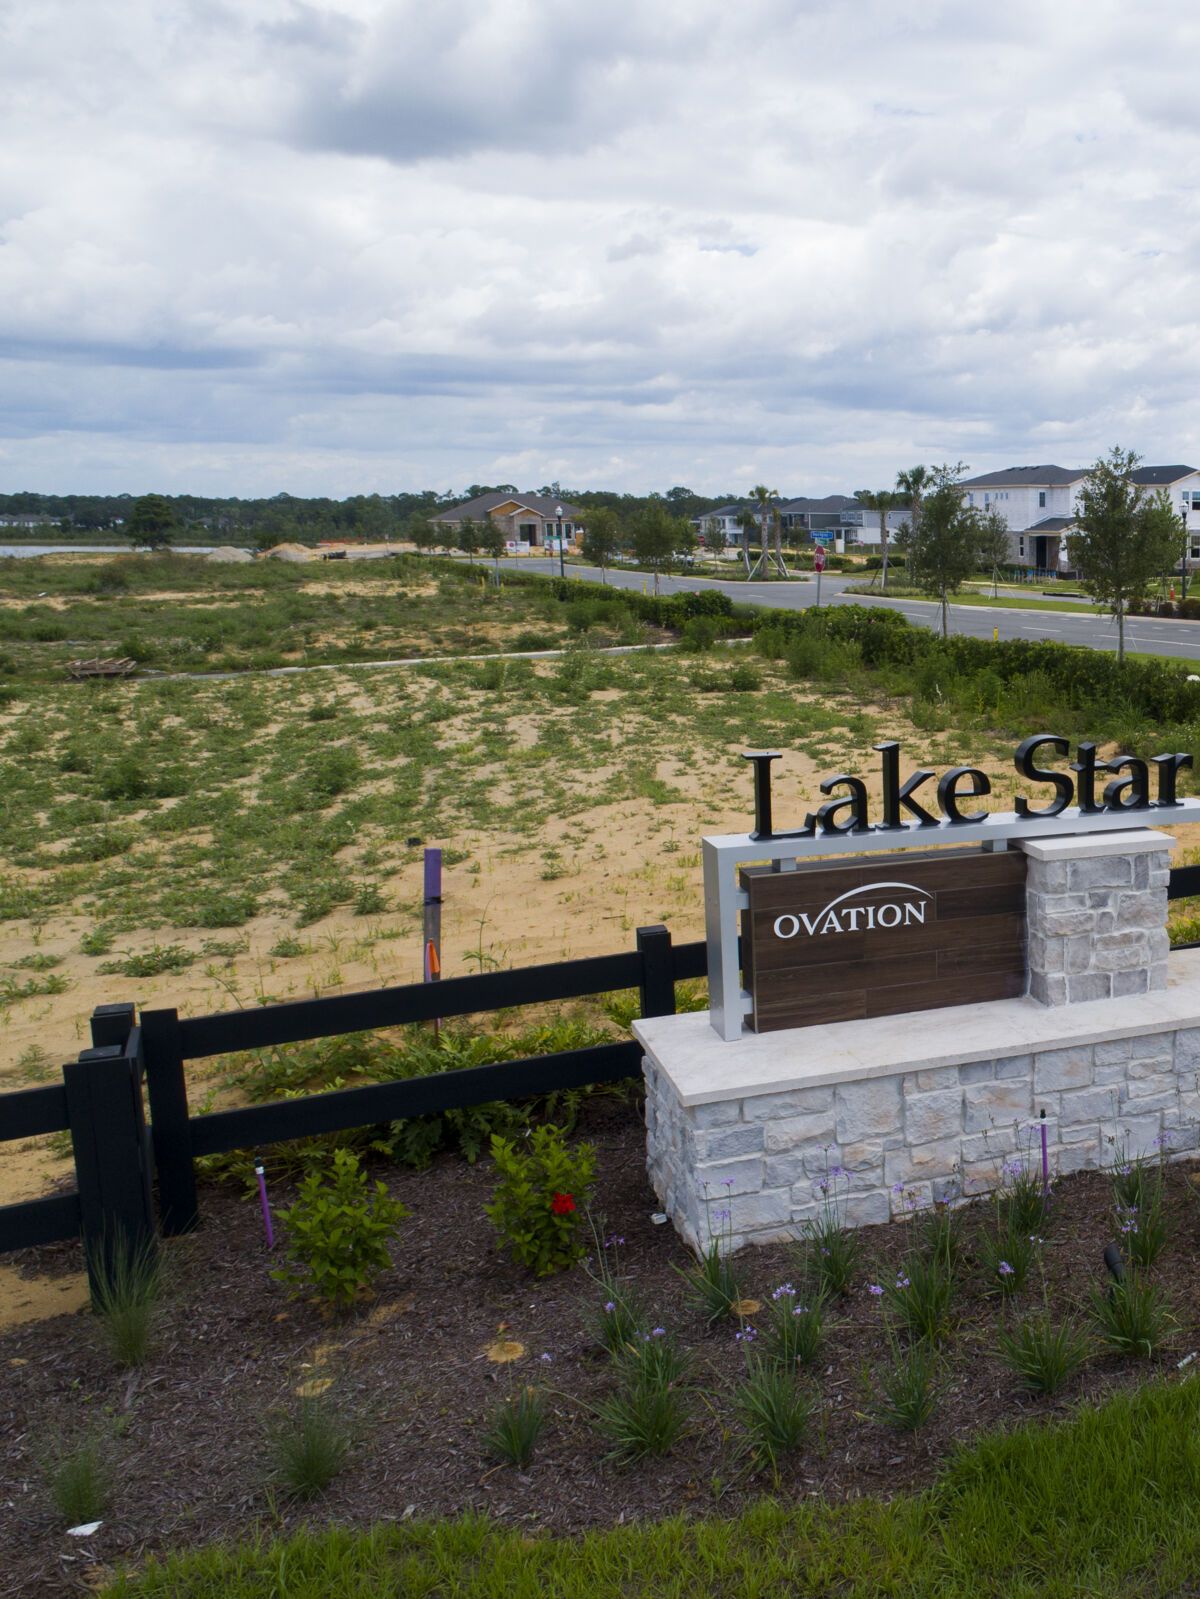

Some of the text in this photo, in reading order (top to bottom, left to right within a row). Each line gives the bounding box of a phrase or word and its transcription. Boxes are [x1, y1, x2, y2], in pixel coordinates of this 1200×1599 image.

[741, 734, 1194, 841] Lake Star
[773, 900, 927, 939] OVATION
